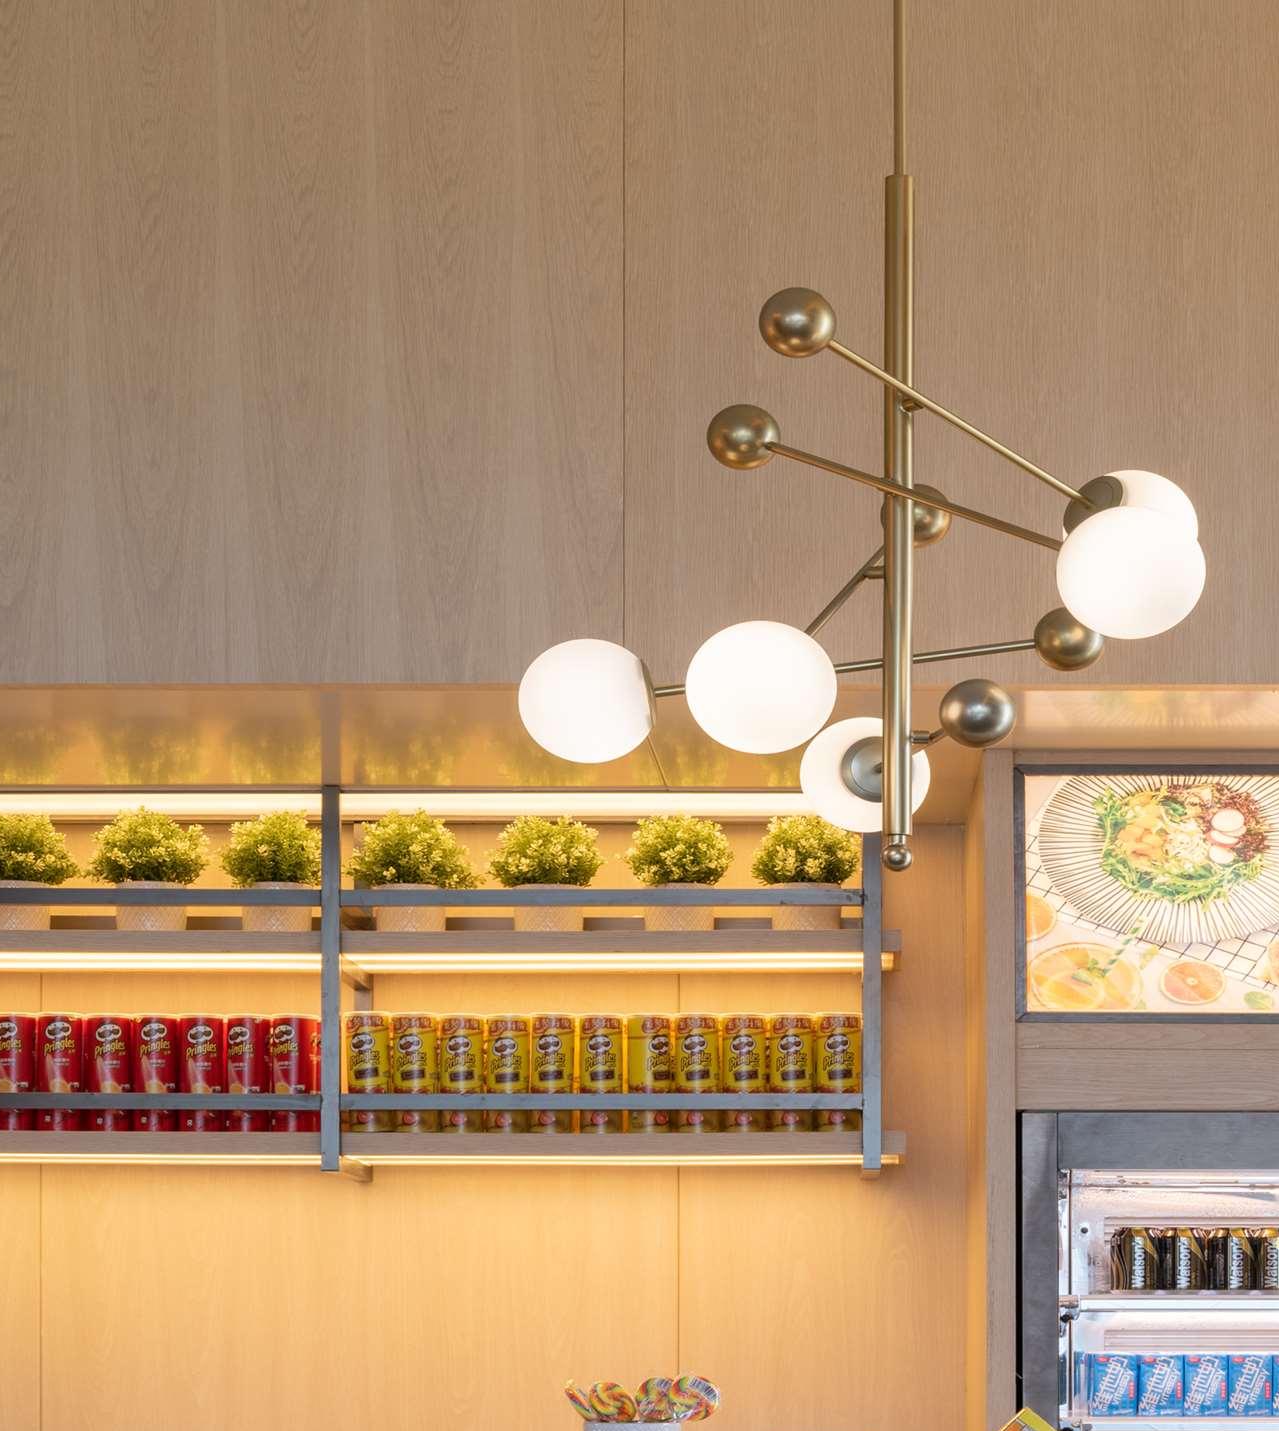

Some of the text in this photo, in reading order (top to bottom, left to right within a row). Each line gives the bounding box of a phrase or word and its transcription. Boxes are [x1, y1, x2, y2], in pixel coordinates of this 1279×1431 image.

[44, 1039, 75, 1056] Pringles
[95, 1040, 126, 1058] Pringles
[139, 1039, 171, 1057] Pringles
[185, 1042, 217, 1060] Pringles
